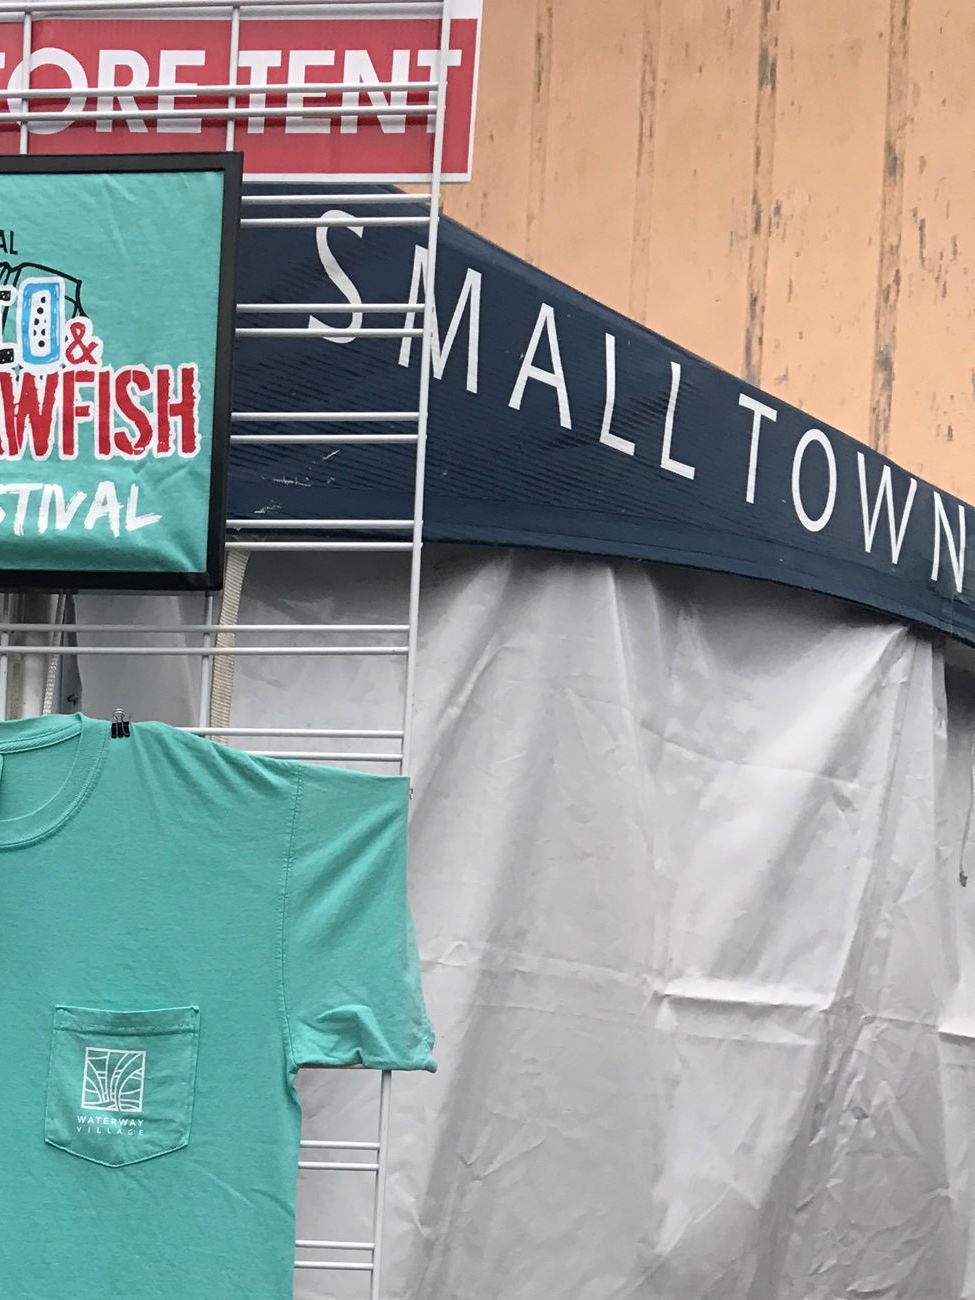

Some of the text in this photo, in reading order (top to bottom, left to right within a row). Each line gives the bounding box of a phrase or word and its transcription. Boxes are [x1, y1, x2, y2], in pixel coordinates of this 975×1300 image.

[237, 49, 463, 134] TENT
[65, 321, 99, 365] &
[309, 209, 967, 593] SMALL TOWN
[76, 1115, 145, 1127] WATERWAY
[76, 1126, 146, 1136] VILLAGE
